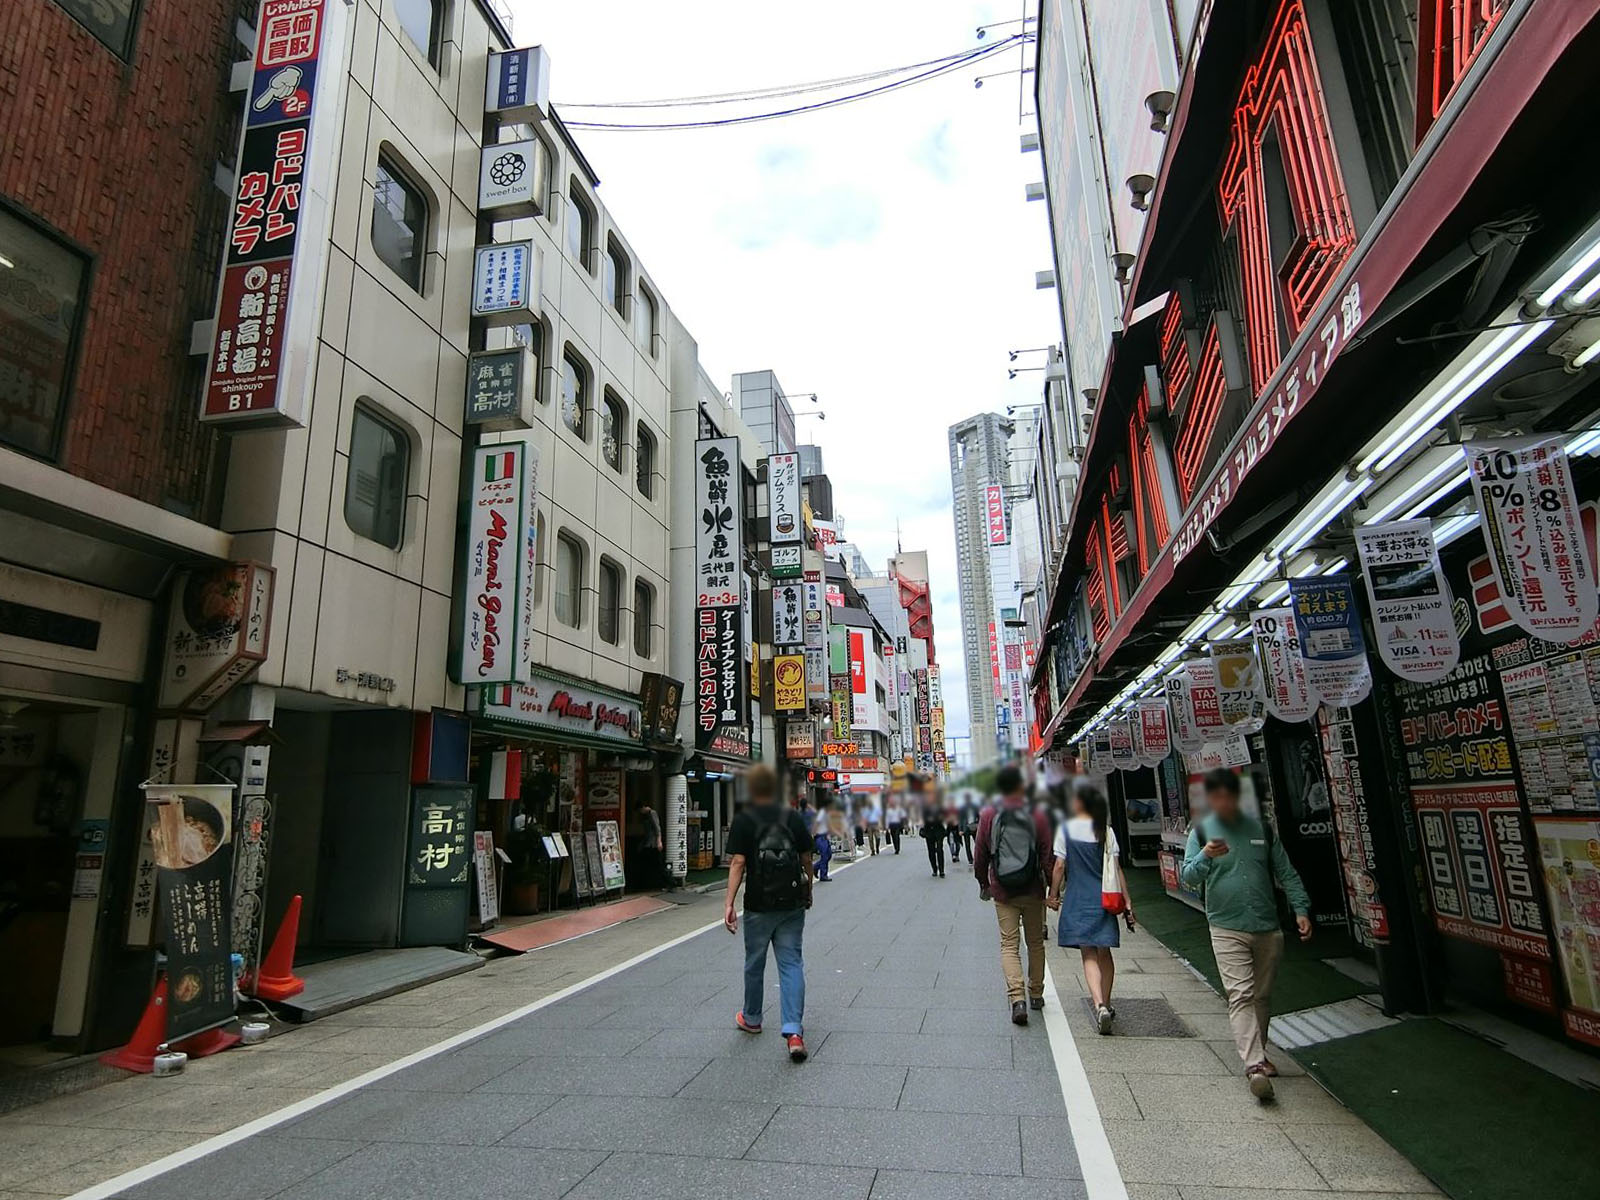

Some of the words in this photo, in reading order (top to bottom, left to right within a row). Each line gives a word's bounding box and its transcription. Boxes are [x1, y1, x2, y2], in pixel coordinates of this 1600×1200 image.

[270, 13, 314, 39] 高価
[268, 35, 311, 60] 買取
[286, 96, 307, 113] 2F
[265, 128, 306, 242] ヨドバシ
[485, 189, 510, 199] sweet
[511, 186, 528, 196] box
[232, 171, 269, 255] カメラ
[222, 383, 264, 394] shinkouyo
[228, 393, 253, 411] B1
[473, 390, 514, 412] 高村
[988, 490, 1004, 538] カラオケ
[1172, 467, 1231, 569] ヨドバシカメラ
[1539, 488, 1562, 527] 8%
[1476, 450, 1524, 508] 10%
[1506, 507, 1547, 612] ポイント還元
[474, 540, 484, 577] マイアミ
[485, 509, 508, 594] Miami
[774, 549, 798, 557] ゴルフ
[1366, 549, 1432, 563] ポイントカード
[701, 562, 735, 575] 三代目
[1297, 600, 1348, 615] 買えます
[1298, 588, 1346, 603] ネットで
[1377, 601, 1442, 615] クレジット払いが
[249, 579, 264, 642] らーめん
[1307, 614, 1344, 624] 約600万
[1529, 616, 1579, 625] ヨドバシカメラ
[470, 611, 480, 651] ガーデン
[1418, 629, 1432, 641] 11
[1391, 646, 1420, 657] VISA
[1428, 645, 1436, 657] 1
[699, 610, 717, 732] ヨドバシカメラ
[721, 610, 737, 722] ケータイアクセサリー館
[1271, 648, 1290, 707] ポイント還元
[776, 687, 803, 699] やきとり
[777, 696, 804, 706] センター
[1194, 700, 1218, 710] FRE
[1220, 690, 1254, 702] アプリ
[1400, 699, 1503, 747] ヨドバシカメラ
[1423, 735, 1514, 780] スピード配達
[417, 802, 456, 872] 高村
[1422, 815, 1453, 884] 即日
[1455, 815, 1491, 889] 翌日
[1493, 814, 1534, 897] 指定日
[1434, 886, 1461, 914] 配達
[1467, 890, 1500, 922] 配達
[1508, 897, 1544, 931] 配達
